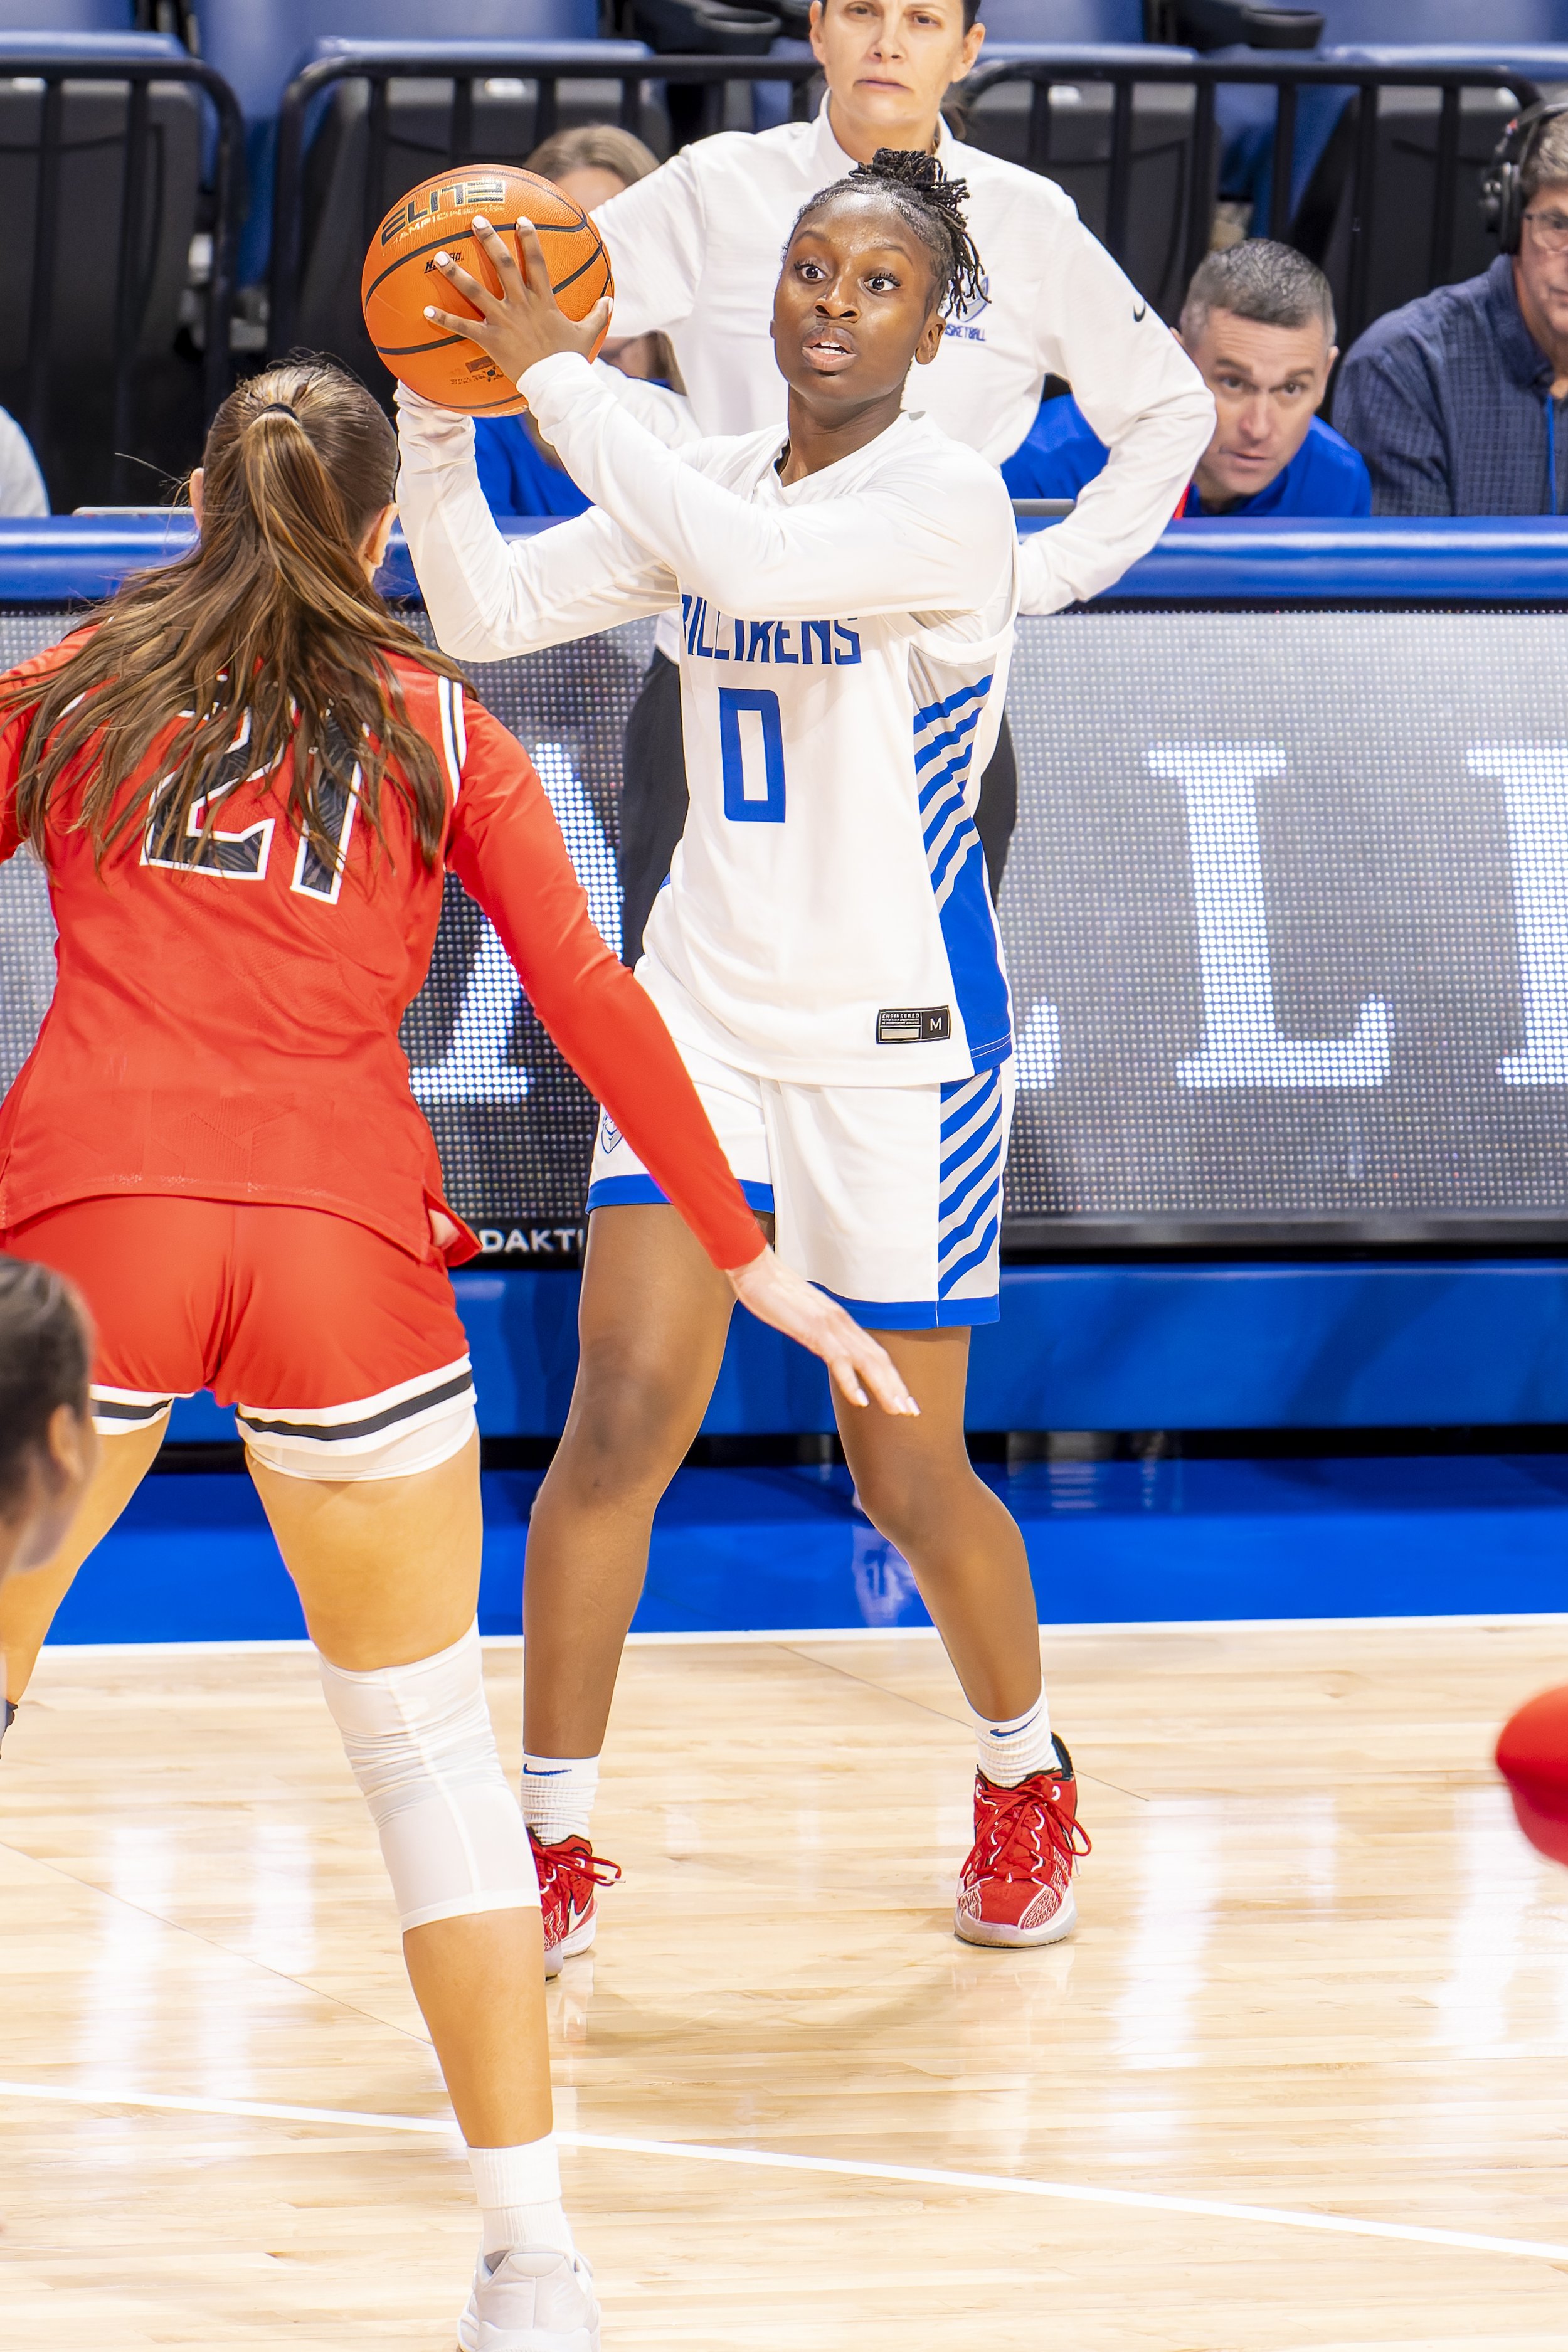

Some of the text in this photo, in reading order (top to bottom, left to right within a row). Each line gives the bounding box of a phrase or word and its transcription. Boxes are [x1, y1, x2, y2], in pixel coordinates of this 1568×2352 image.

[381, 179, 506, 247] ELITE
[718, 686, 787, 824] 0
[930, 1017, 942, 1032] M
[478, 1228, 585, 1253] DAKT
